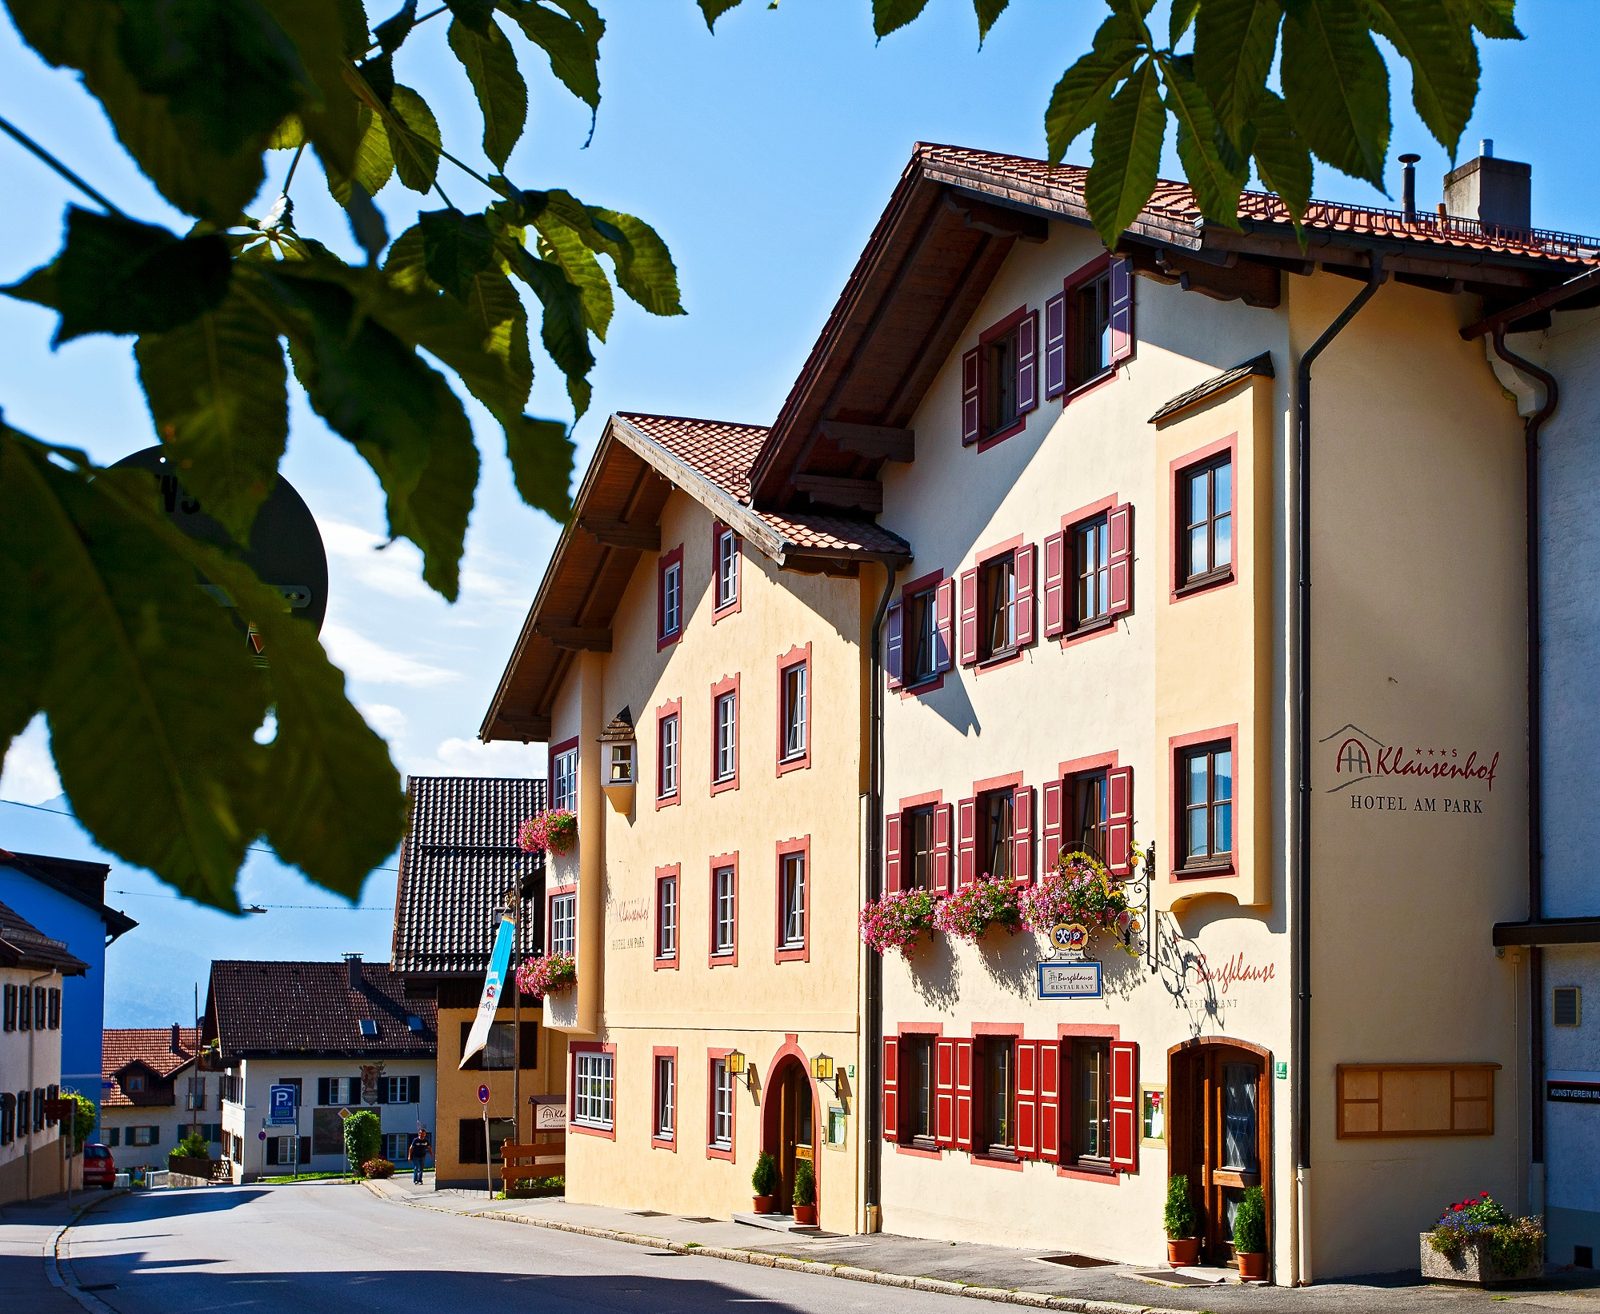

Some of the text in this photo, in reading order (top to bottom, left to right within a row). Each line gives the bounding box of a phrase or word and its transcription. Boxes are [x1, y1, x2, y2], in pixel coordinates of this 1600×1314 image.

[1376, 746, 1500, 792] Klausenhof
[1350, 795, 1483, 814] HOTEL AM PARK
[1057, 972, 1093, 984] Burgklause
[1196, 951, 1276, 994] Burgklause
[1184, 999, 1238, 1009] ESTRANT
[276, 1092, 288, 1106] P
[1551, 1088, 1592, 1098] KUNSTVEREIN
